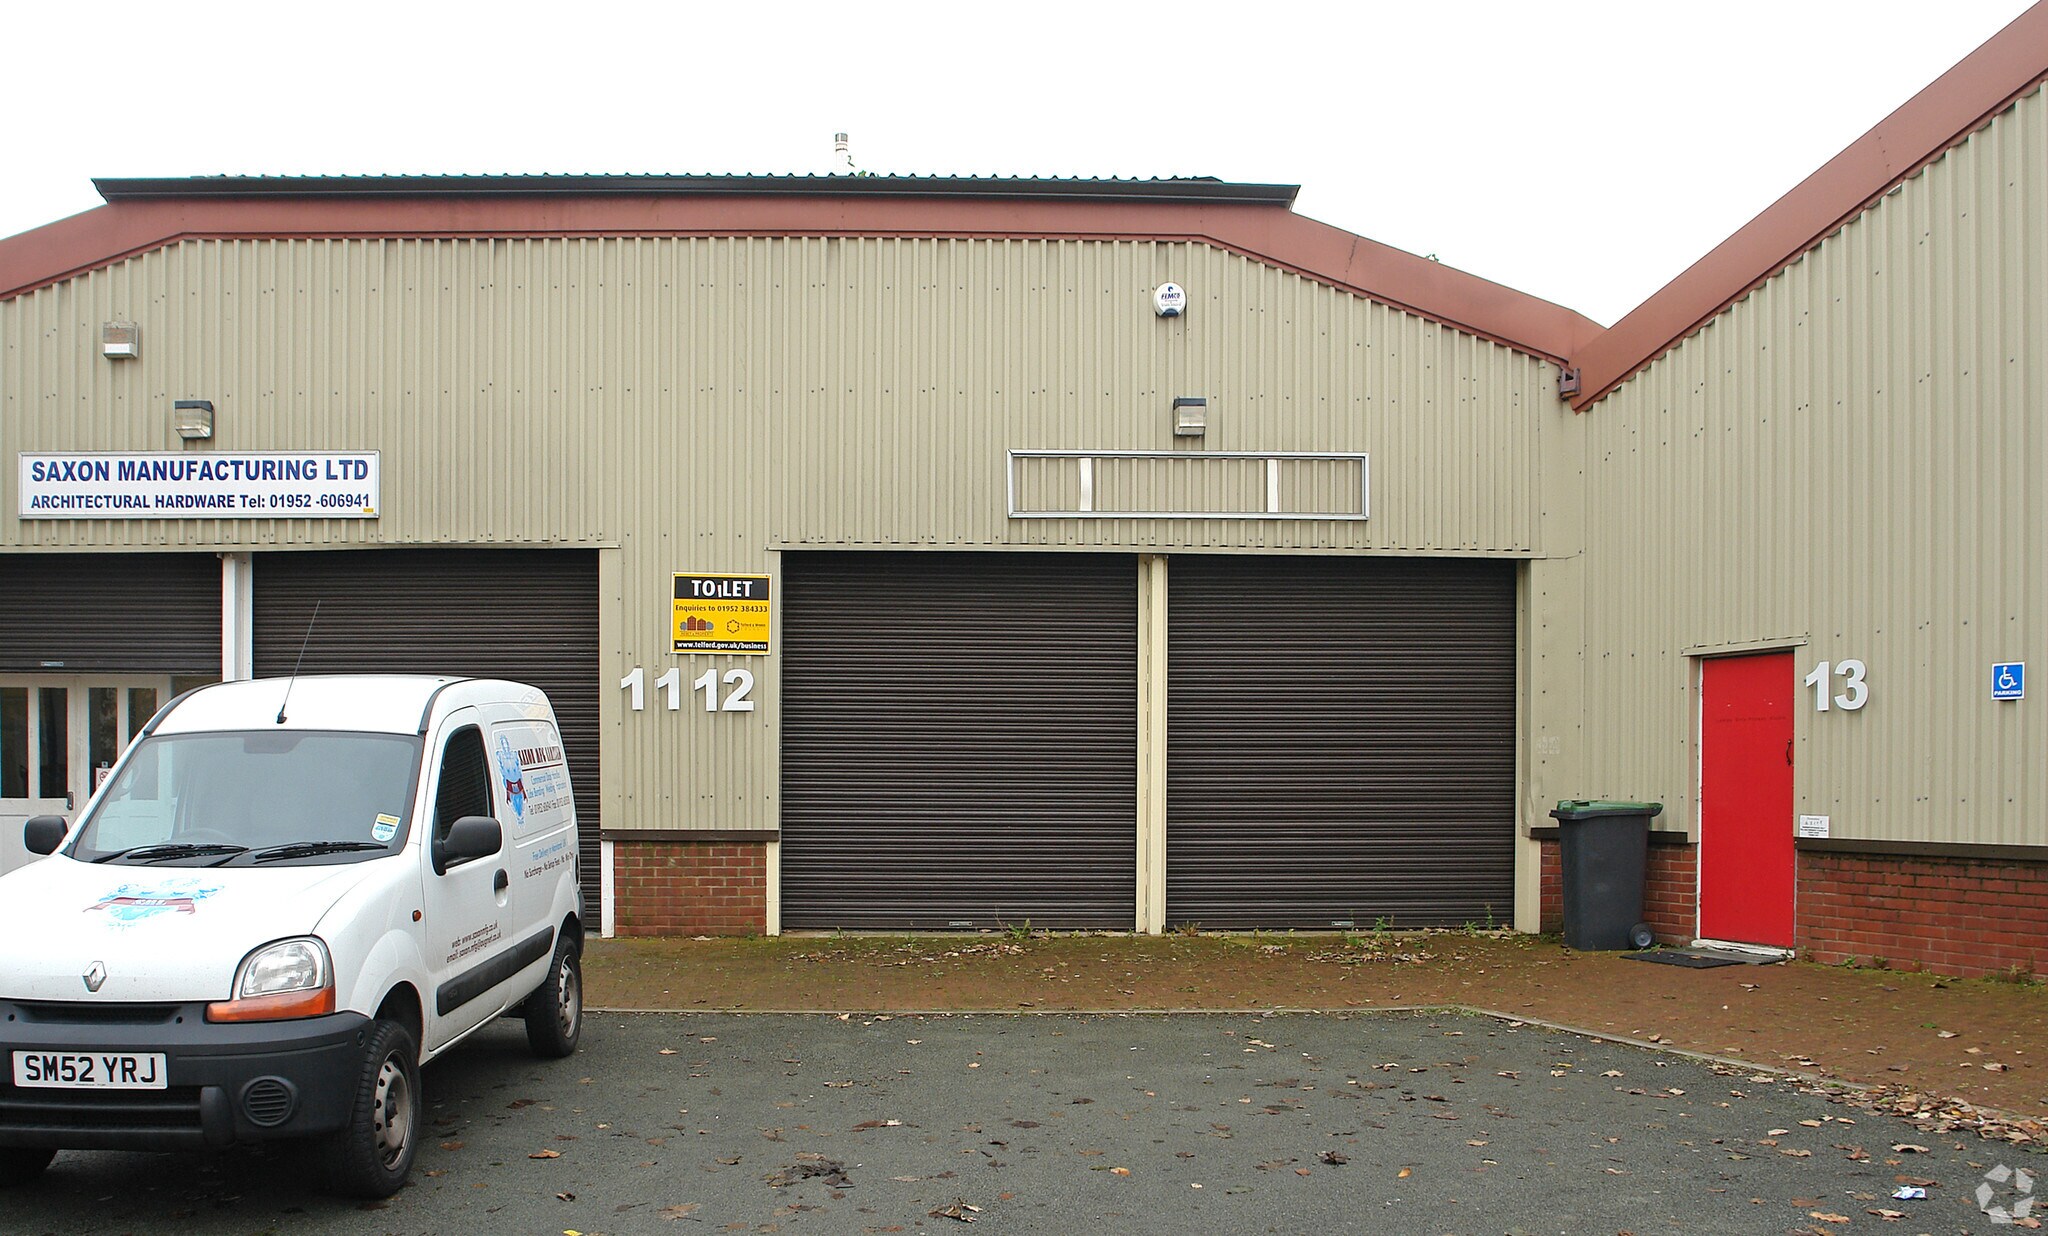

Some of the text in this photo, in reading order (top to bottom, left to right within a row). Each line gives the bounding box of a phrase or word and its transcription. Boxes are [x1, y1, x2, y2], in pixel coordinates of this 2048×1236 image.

[31, 459, 369, 482] SAXON MANUFACTURING LTD
[31, 493, 370, 509] ARCHITECTURAL HARDWARE Tel: 01952 -606941
[675, 604, 706, 613] Enquiries
[741, 605, 768, 613] 384333
[676, 641, 767, 650] www.telford.gov.uk/business
[694, 668, 755, 712] 12
[1805, 659, 1869, 711] 13
[25, 1054, 156, 1083] SM52 YRJ
